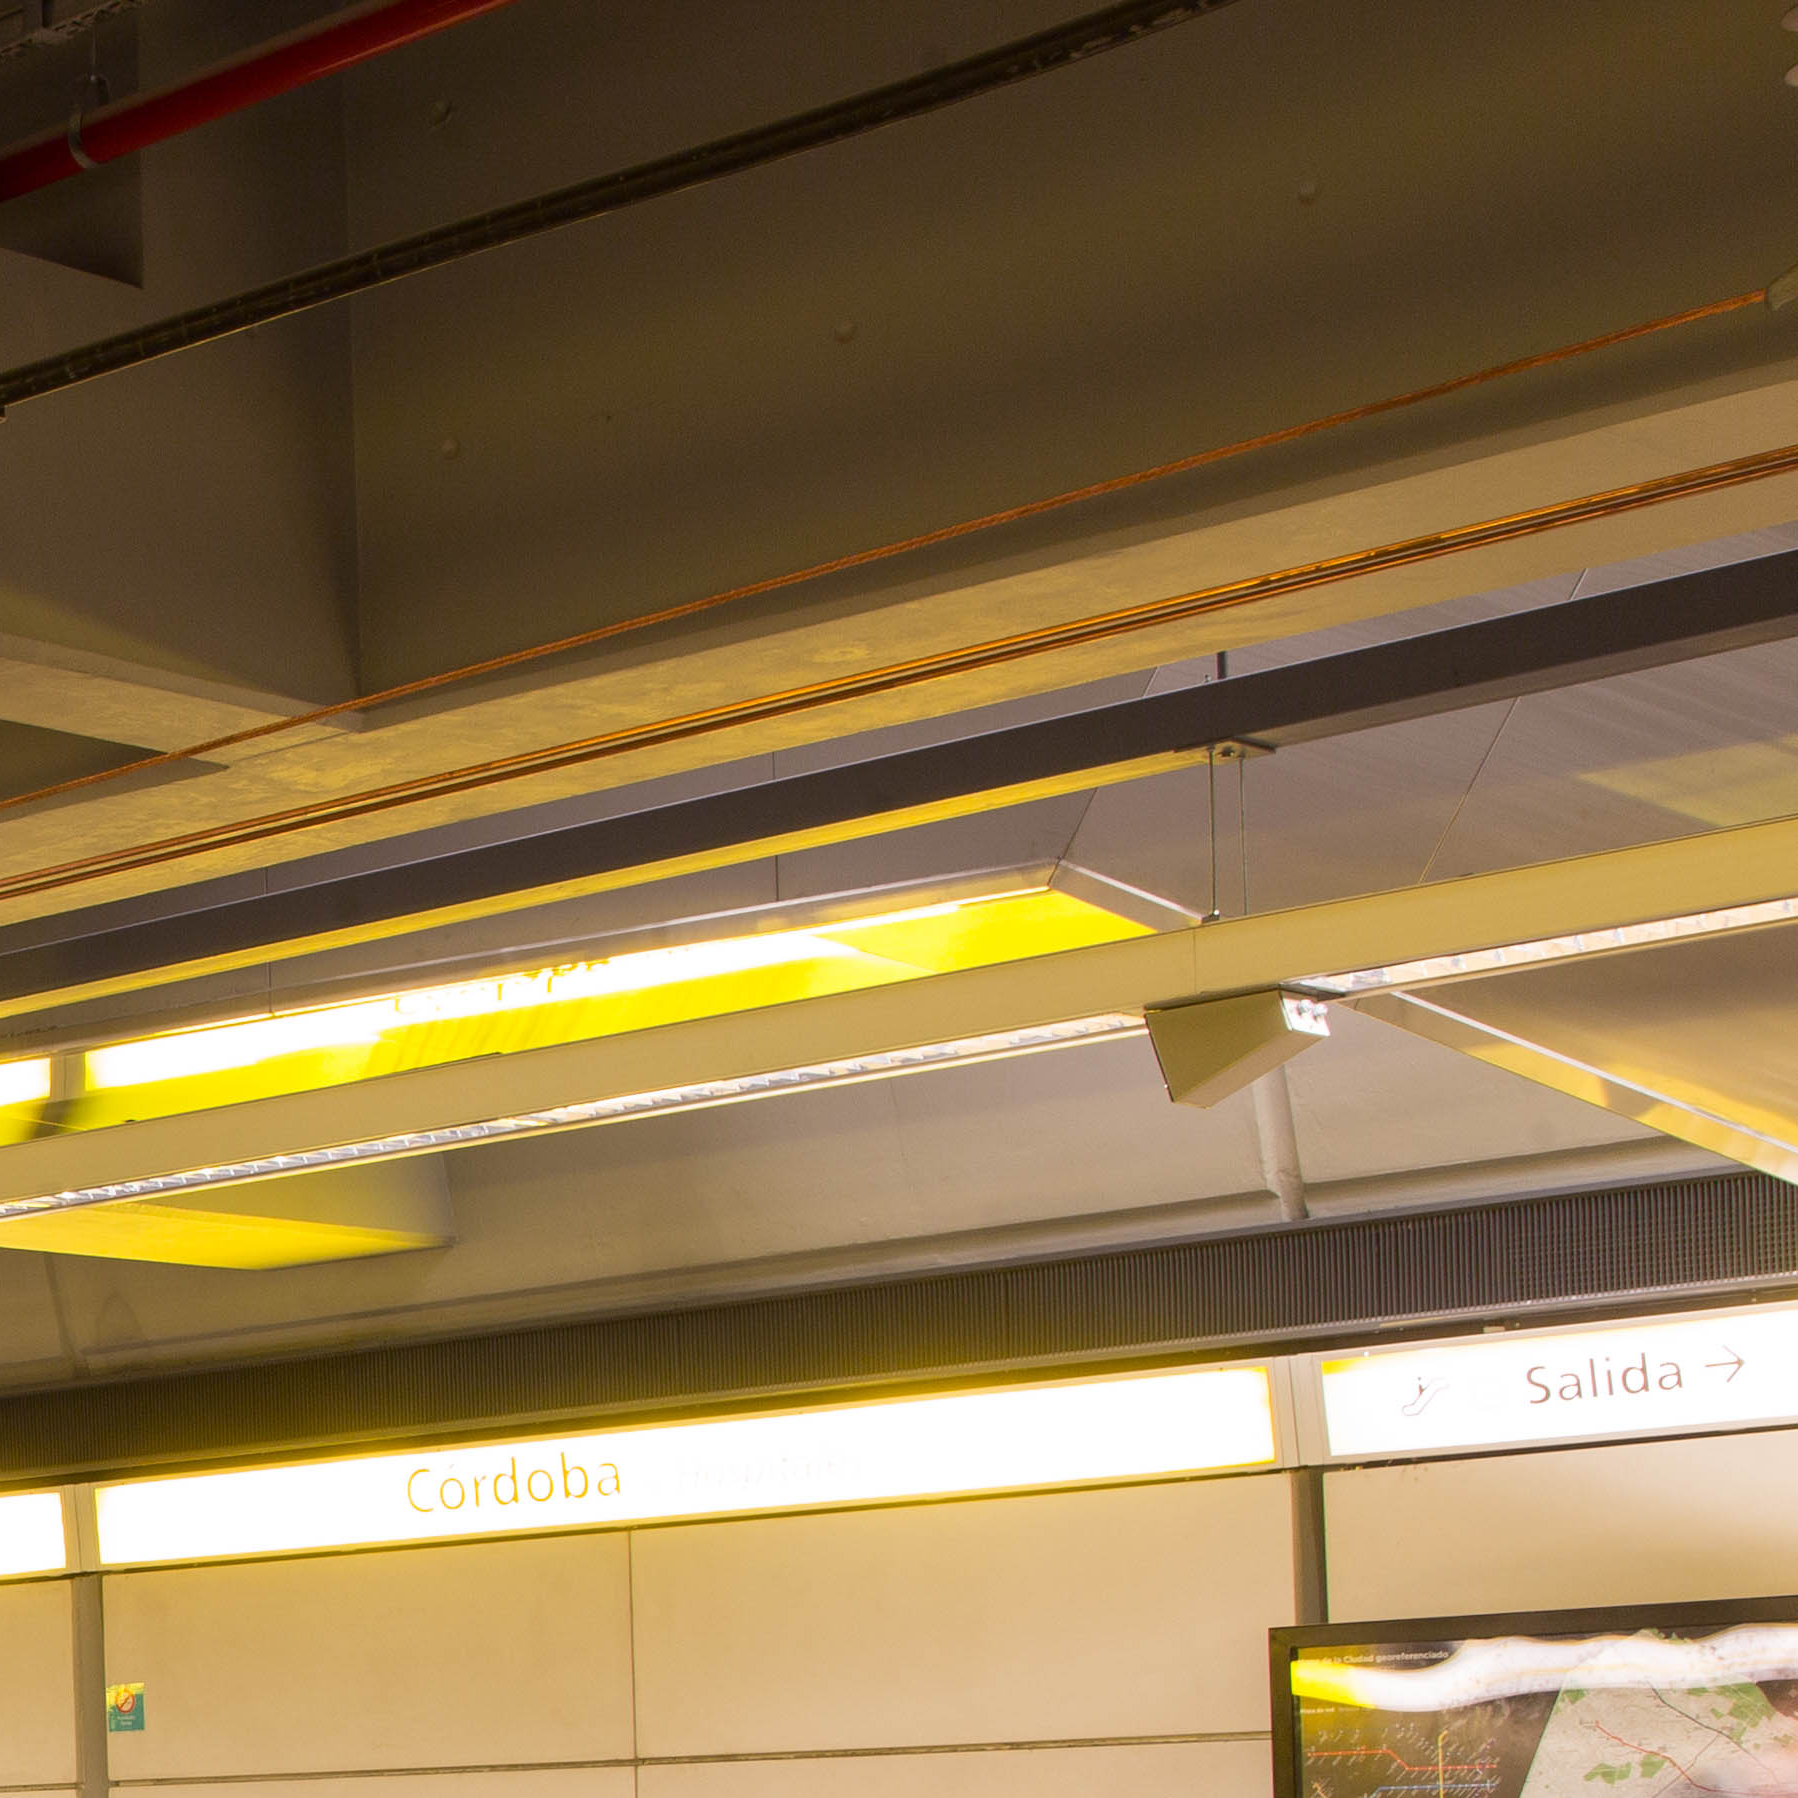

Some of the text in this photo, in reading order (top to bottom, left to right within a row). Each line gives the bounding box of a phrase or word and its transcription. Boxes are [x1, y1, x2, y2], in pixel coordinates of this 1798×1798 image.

[1526, 1352, 1682, 1404] Salida
[1343, 1653, 1374, 1664] Ciudad
[1376, 1651, 1450, 1664] georeferenciado
